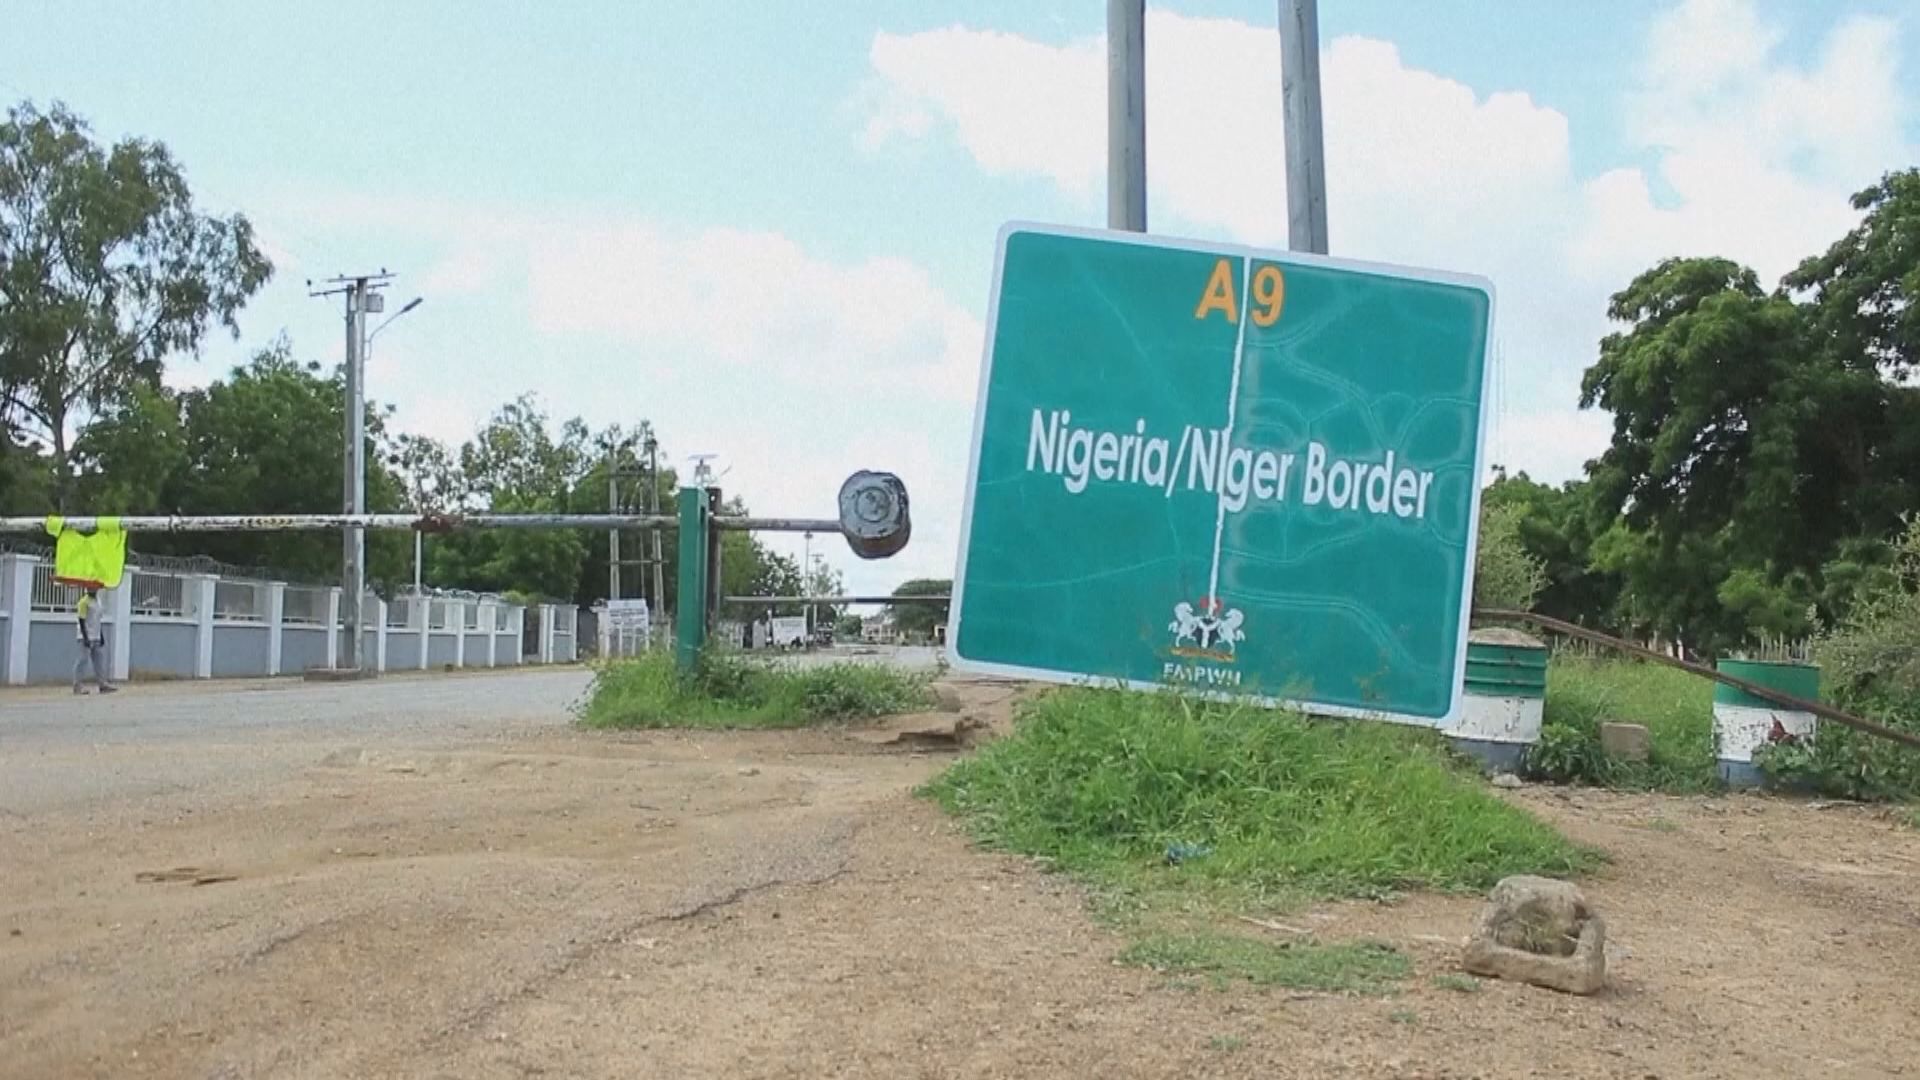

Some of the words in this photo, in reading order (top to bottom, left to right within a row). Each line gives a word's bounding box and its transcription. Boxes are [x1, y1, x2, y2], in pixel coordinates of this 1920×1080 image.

[1194, 258, 1285, 328] A9
[1026, 408, 1295, 513] Nigeria/Niger
[1302, 441, 1434, 519] Border
